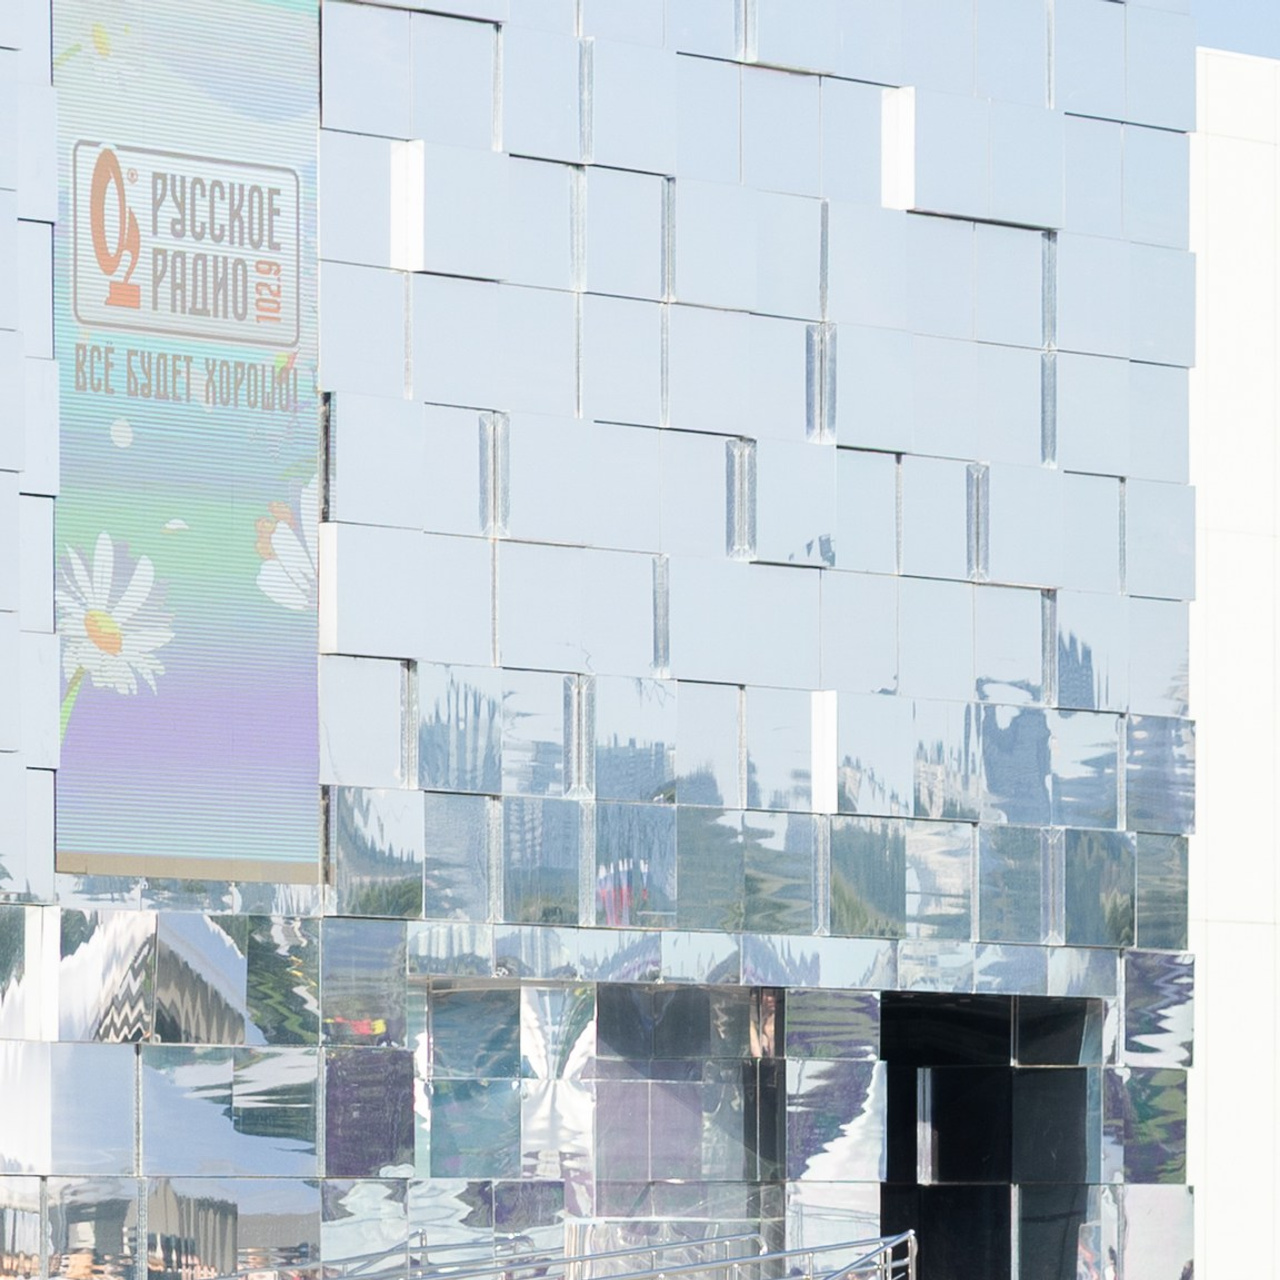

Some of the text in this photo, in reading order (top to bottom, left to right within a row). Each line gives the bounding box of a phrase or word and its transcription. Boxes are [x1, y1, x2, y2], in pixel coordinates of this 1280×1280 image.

[152, 171, 281, 252] РУССКОЕ
[152, 247, 248, 322] РАДИО
[255, 260, 282, 323] 102.9
[127, 349, 193, 403] БУДЕТ
